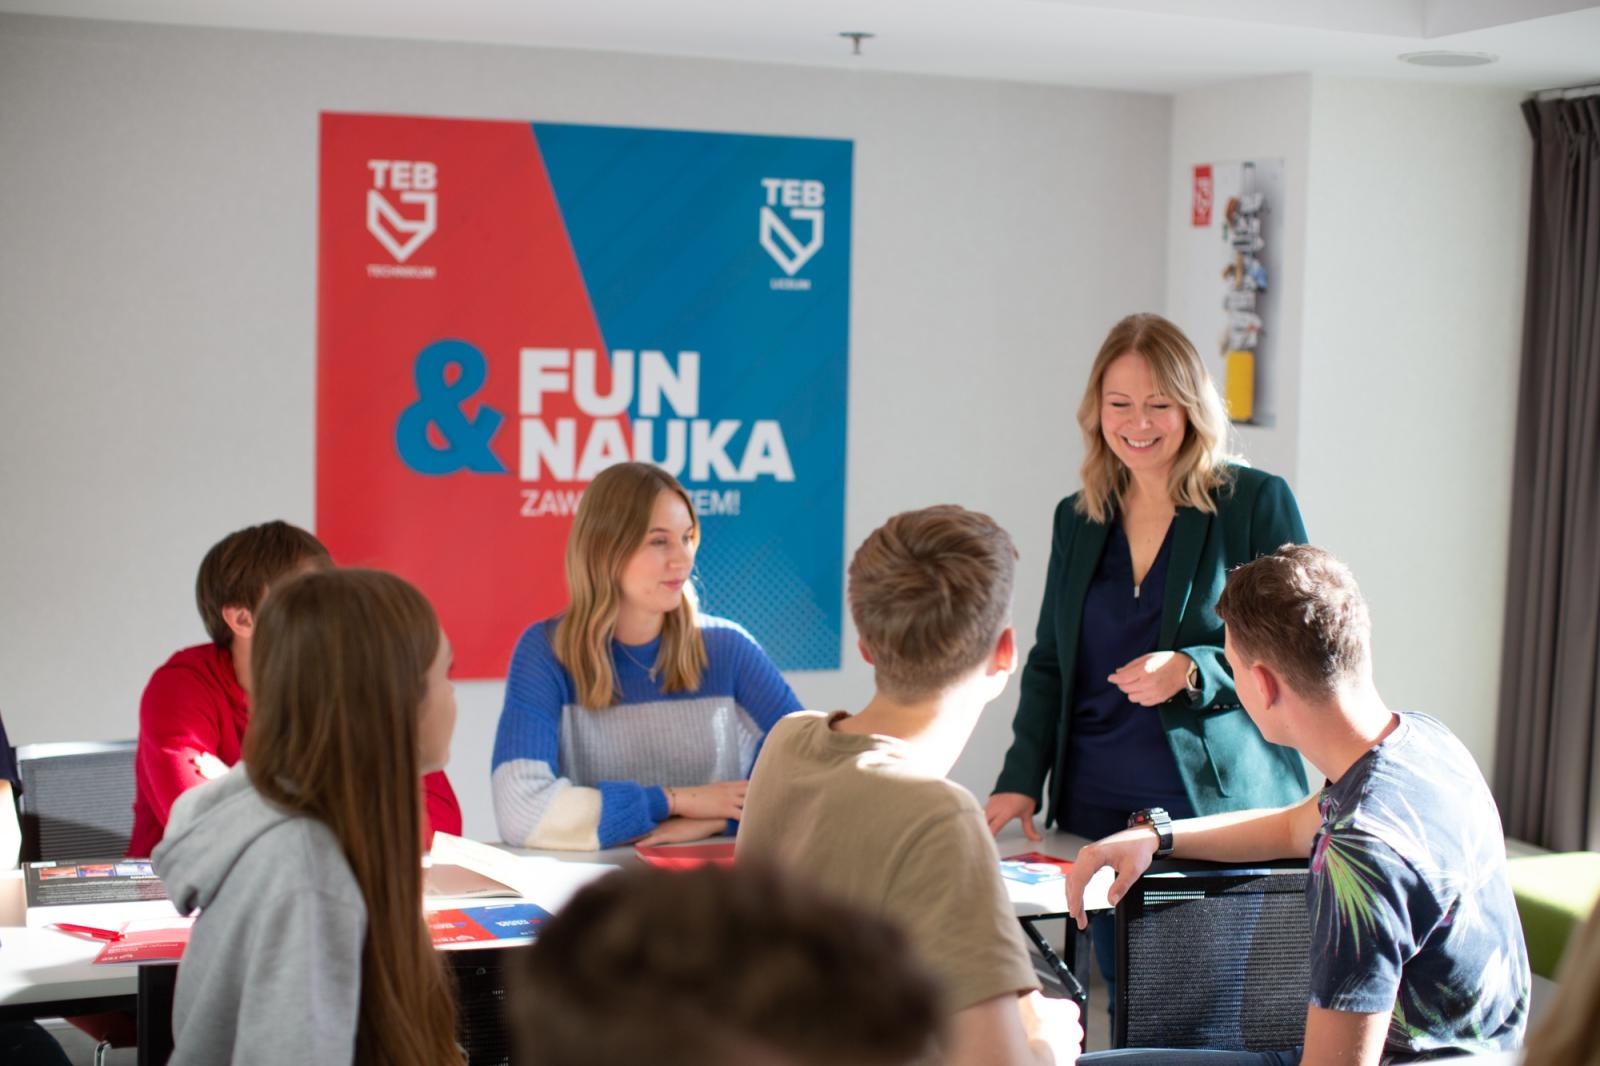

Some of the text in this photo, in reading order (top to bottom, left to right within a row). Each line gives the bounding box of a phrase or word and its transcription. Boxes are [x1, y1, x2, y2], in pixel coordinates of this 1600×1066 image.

[367, 160, 437, 190] TEB
[761, 178, 825, 207] TEB
[519, 347, 699, 418] FUN
[395, 338, 509, 476] &
[519, 417, 795, 482] NAUKA
[521, 489, 741, 517] ZAW EM!
